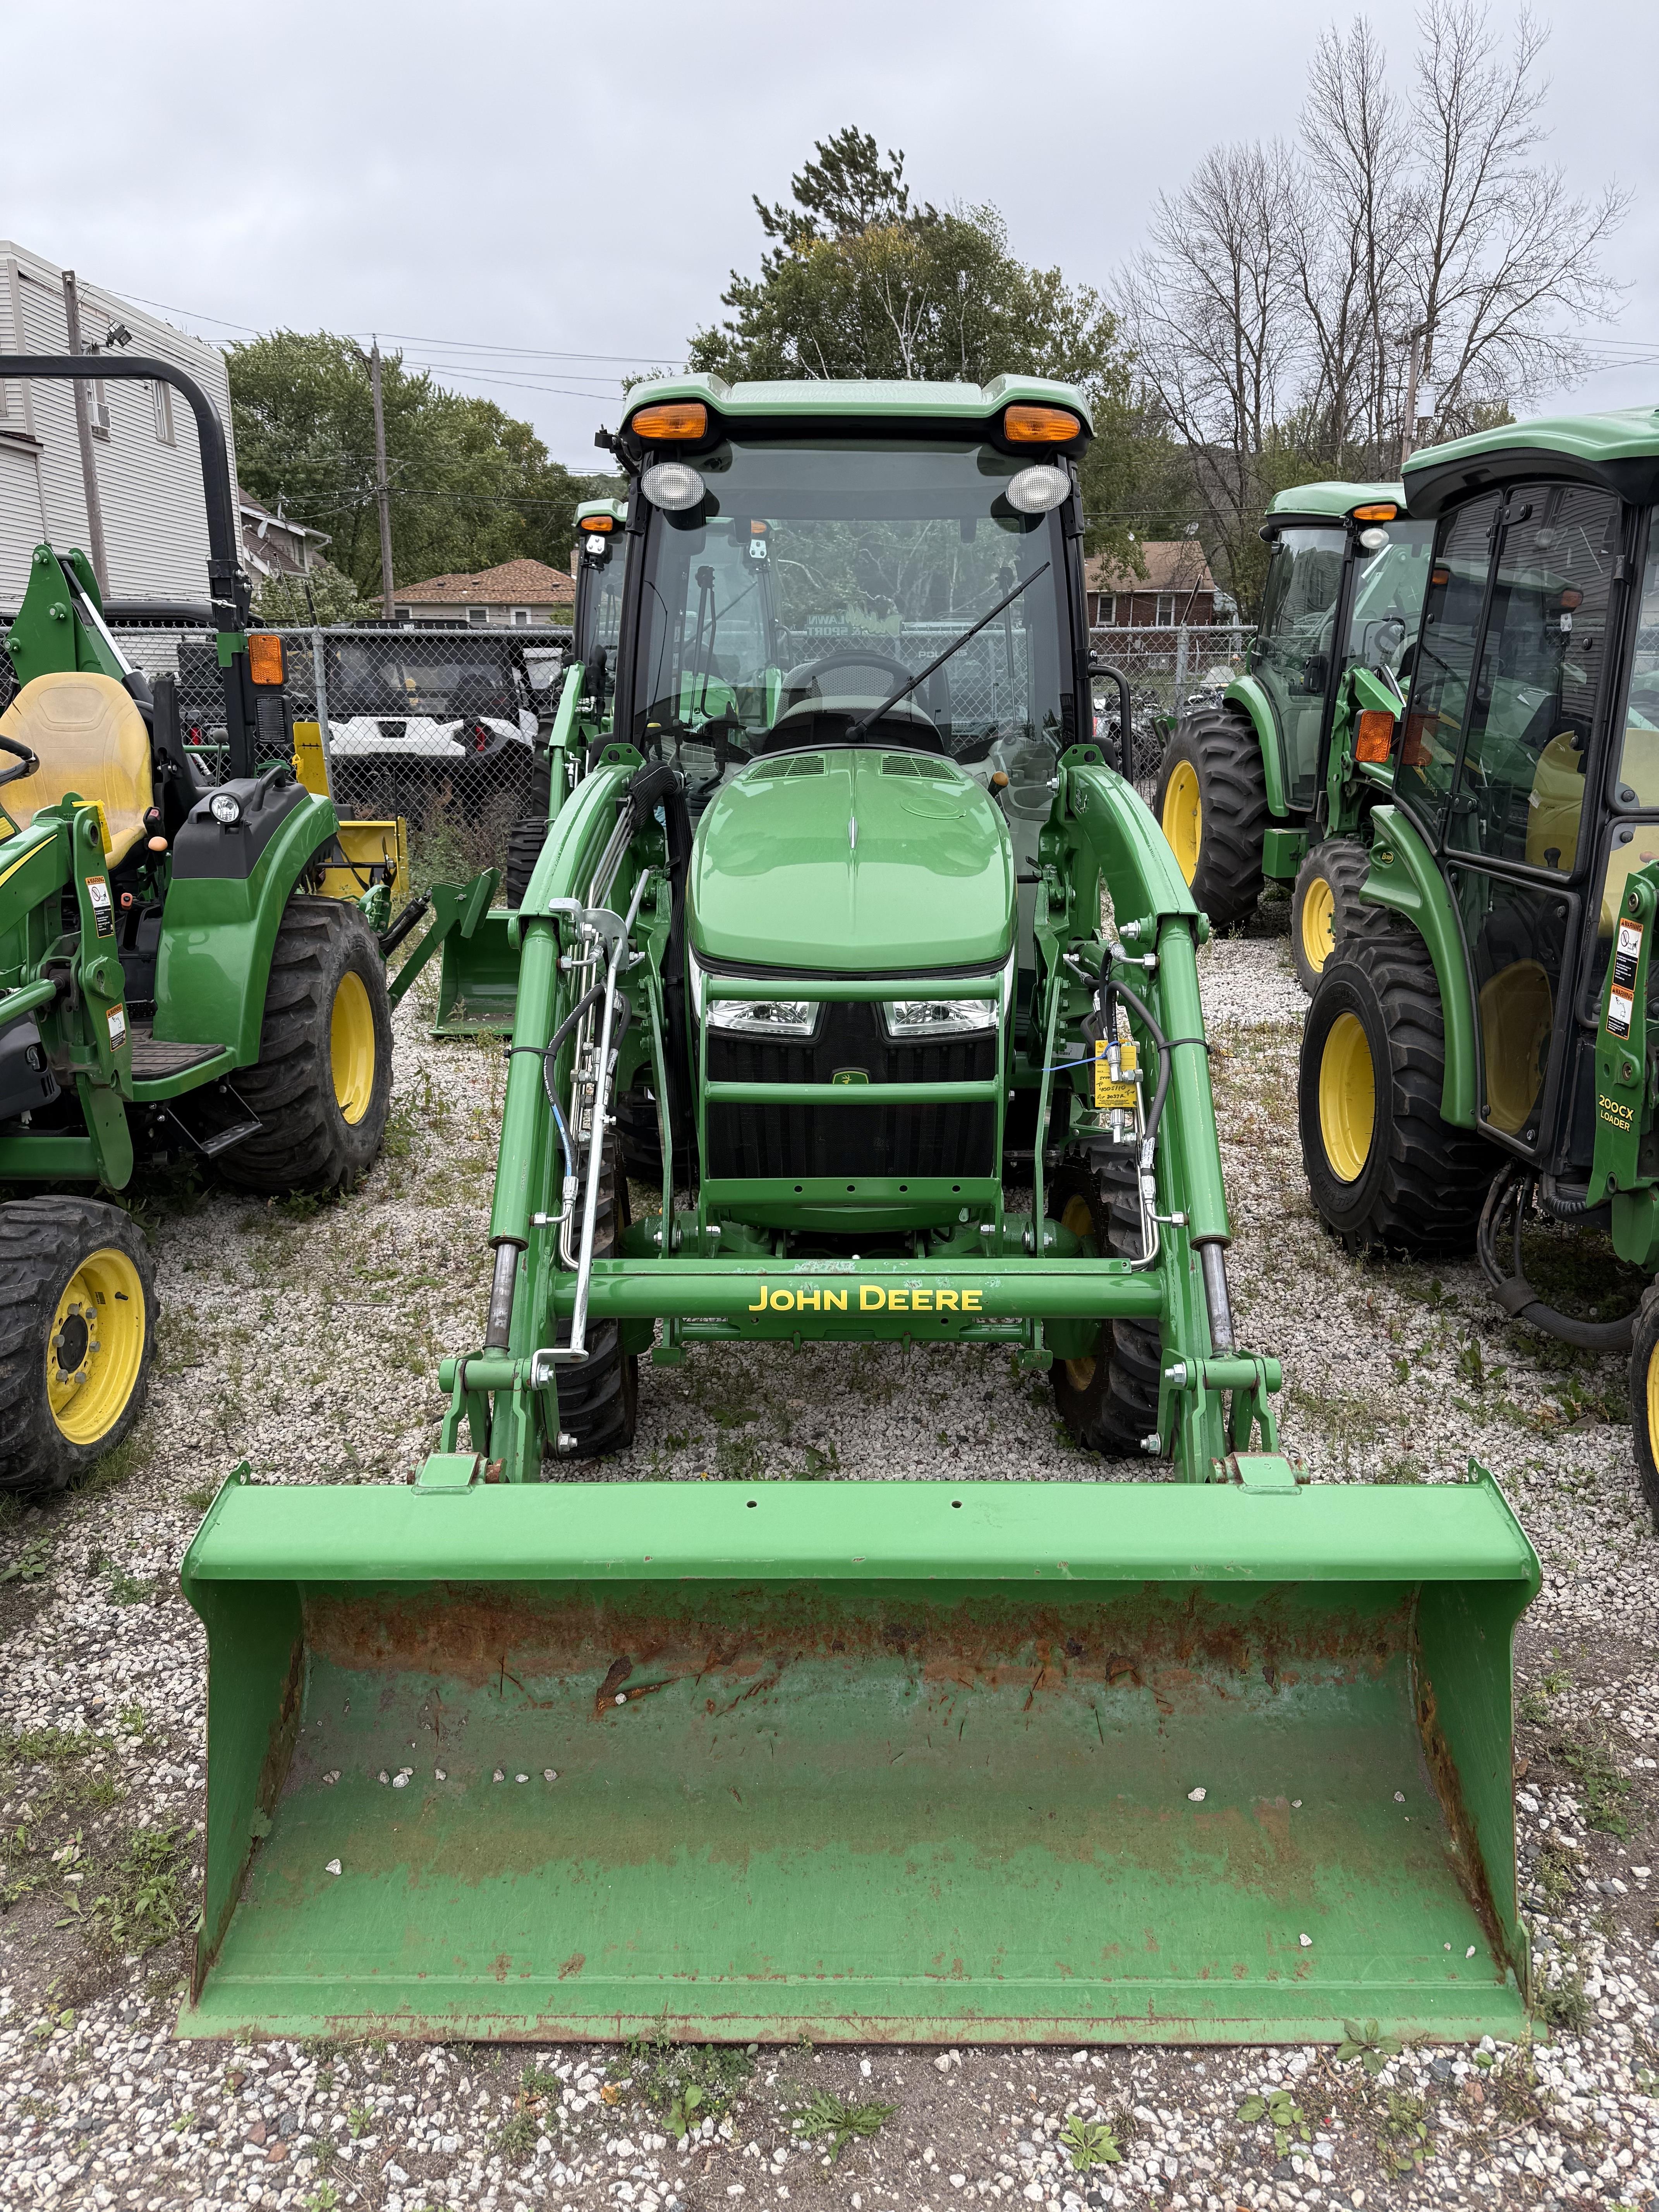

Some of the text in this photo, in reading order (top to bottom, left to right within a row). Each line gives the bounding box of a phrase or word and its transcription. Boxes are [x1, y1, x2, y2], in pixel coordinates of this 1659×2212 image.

[919, 649, 967, 658] POLIS
[1624, 920, 1642, 931] WARNING
[1615, 988, 1633, 1000] WARNING
[1599, 1094, 1634, 1121] 200CX
[1601, 1109, 1630, 1132] LOADER
[749, 1285, 983, 1311] JOHN DEERE
